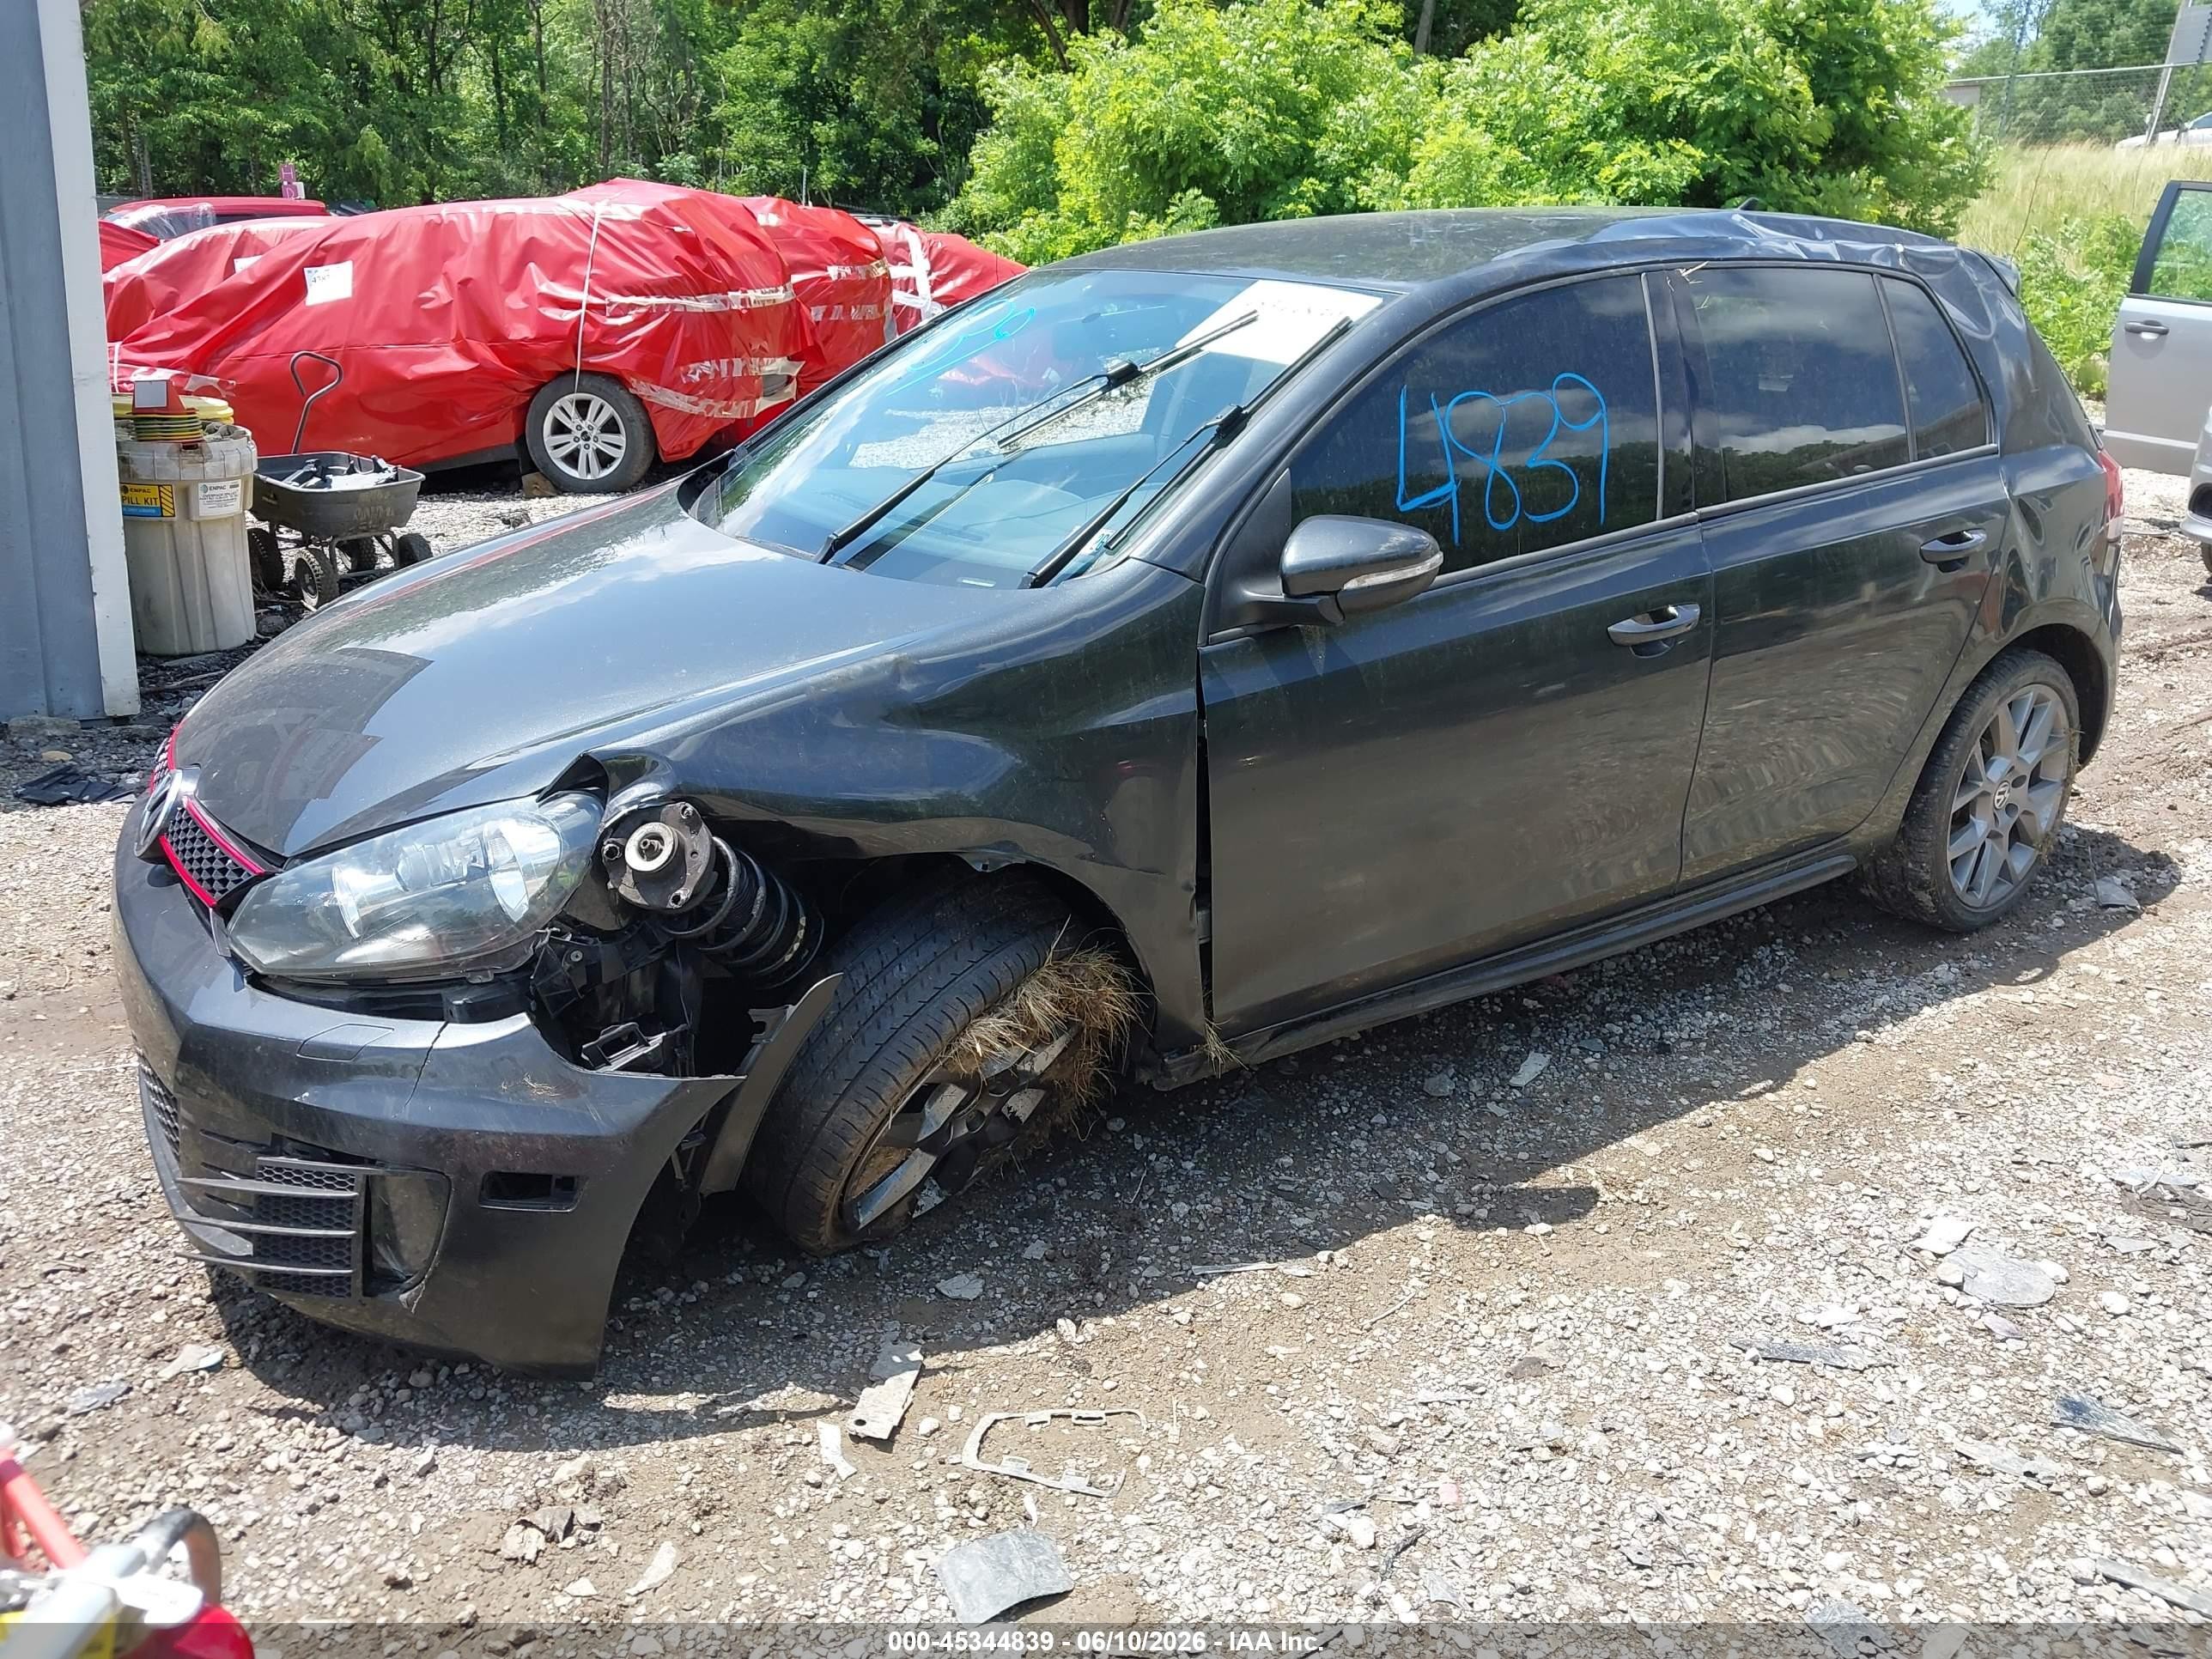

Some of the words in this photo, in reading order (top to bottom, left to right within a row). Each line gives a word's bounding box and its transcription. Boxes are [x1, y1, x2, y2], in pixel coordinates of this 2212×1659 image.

[122, 495, 140, 505] PILL
[143, 496, 159, 506] KIT
[1395, 371, 1609, 548] 4839
